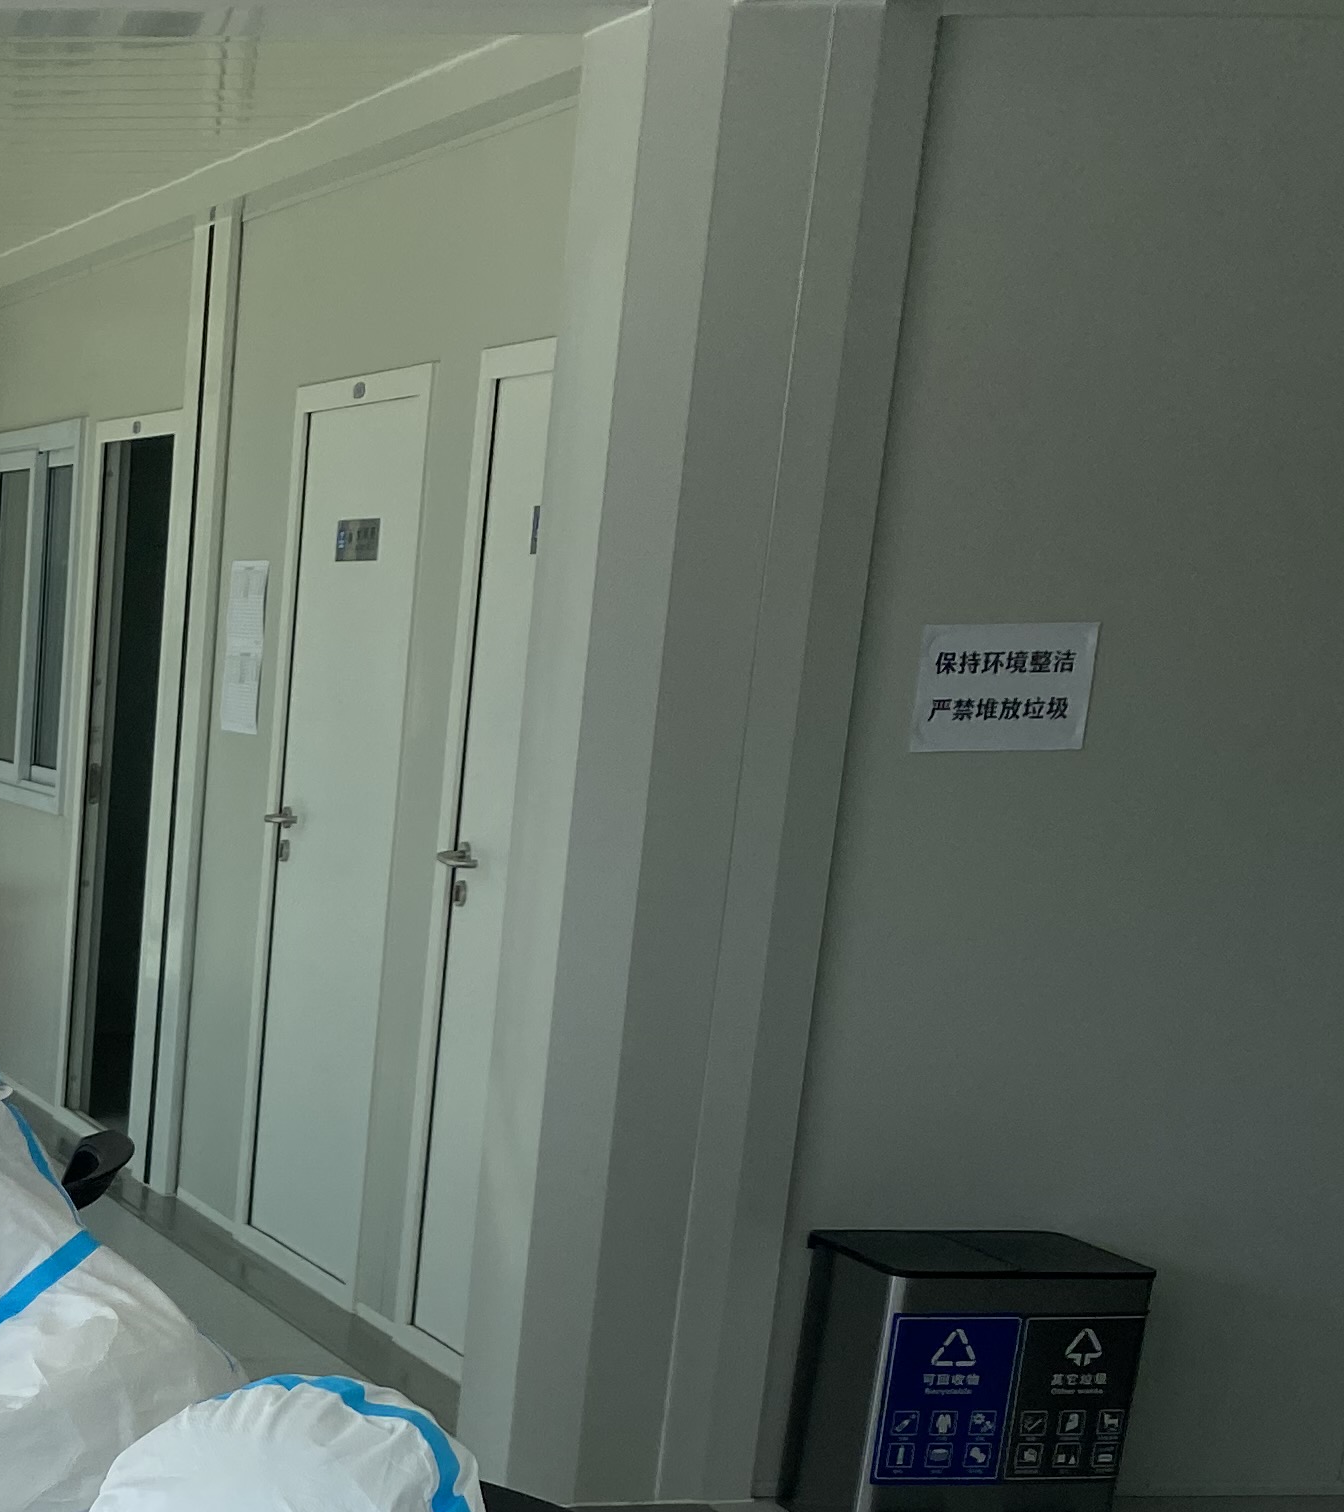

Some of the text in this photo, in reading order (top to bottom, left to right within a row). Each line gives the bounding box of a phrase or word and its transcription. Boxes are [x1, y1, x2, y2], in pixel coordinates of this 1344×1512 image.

[935, 650, 1077, 675] 保持环境整洁
[928, 696, 1069, 722] 严禁堆放垃圾
